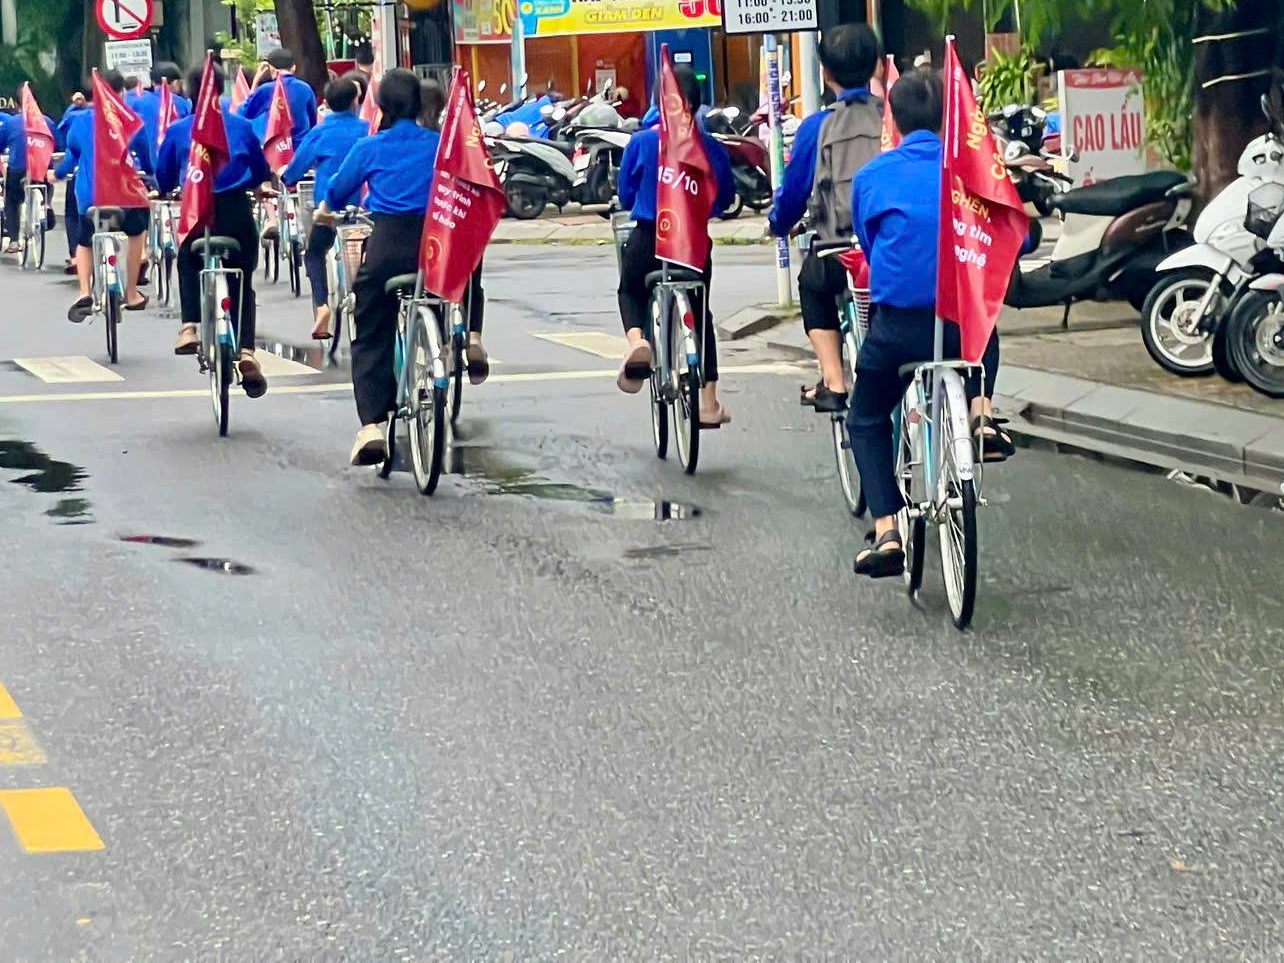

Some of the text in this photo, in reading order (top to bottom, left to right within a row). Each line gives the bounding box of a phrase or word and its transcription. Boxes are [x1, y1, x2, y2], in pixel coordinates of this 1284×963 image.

[739, 12, 769, 25] 16:00
[781, 9, 813, 22] 21:00
[1073, 113, 1105, 152] CAO
